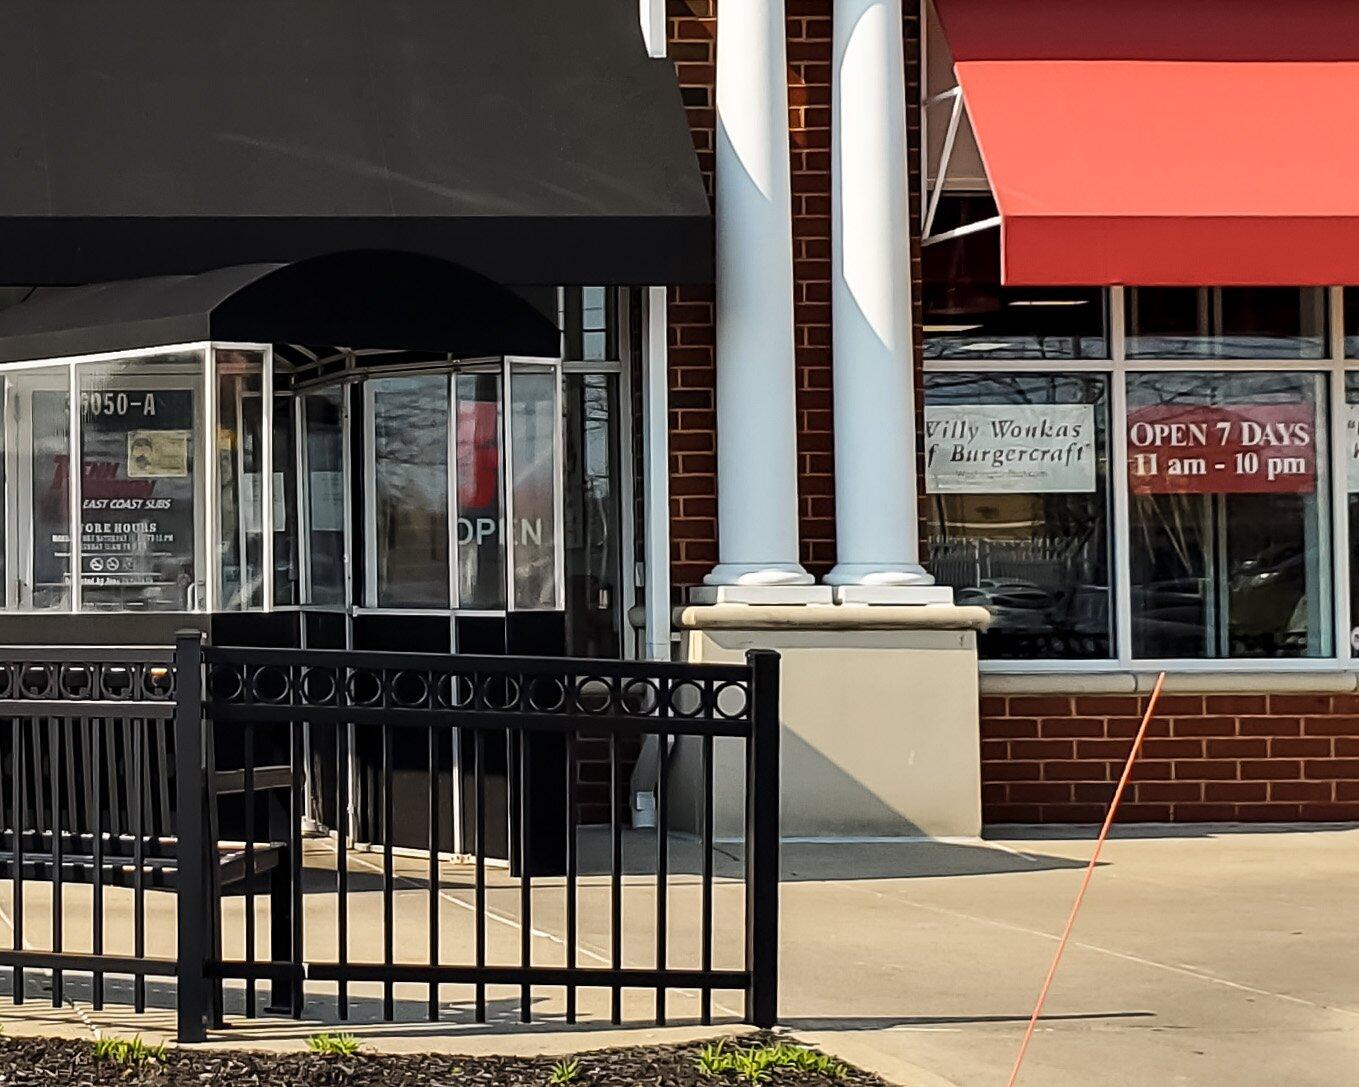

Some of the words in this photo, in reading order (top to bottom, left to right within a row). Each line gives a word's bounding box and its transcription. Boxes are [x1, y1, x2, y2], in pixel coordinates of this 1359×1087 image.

[991, 419, 1082, 439] Wonkas
[1130, 422, 1208, 447] OPEN
[1216, 422, 1231, 446] 7
[1242, 422, 1311, 446] DAYS
[1134, 453, 1158, 475] 11
[1168, 458, 1207, 476] am
[1235, 453, 1258, 474] 10
[1268, 457, 1306, 480] pm
[83, 499, 108, 509] EAST
[110, 499, 142, 509] COAST
[144, 499, 171, 509] SUBS
[114, 522, 157, 533] HOURS
